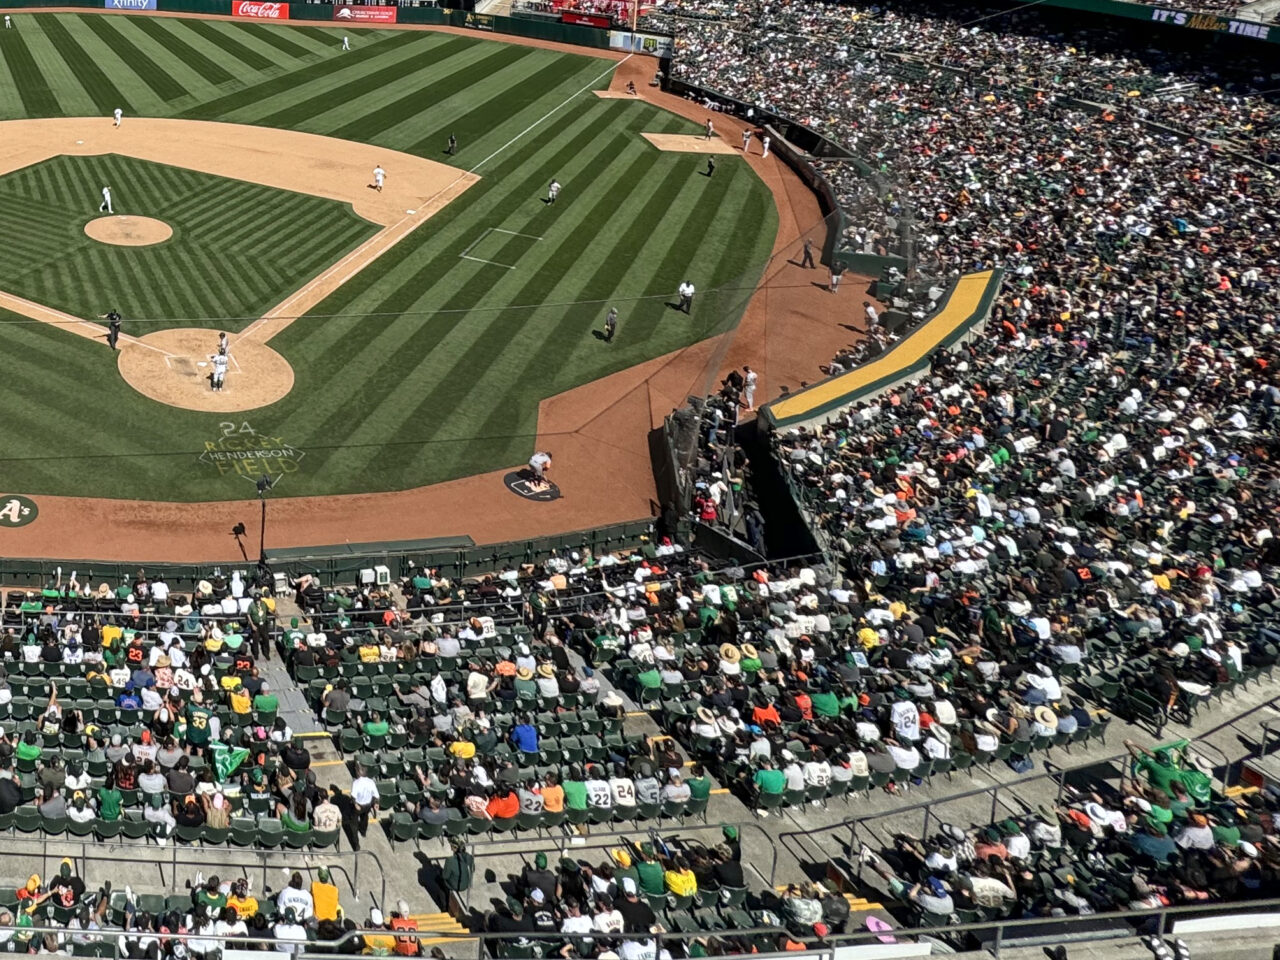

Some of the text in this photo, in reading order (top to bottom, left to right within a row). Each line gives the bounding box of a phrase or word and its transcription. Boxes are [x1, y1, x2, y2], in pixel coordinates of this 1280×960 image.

[238, 1, 282, 18] Coca-Cola
[1152, 9, 1270, 40] IT'S Miller TIME
[220, 421, 256, 437] 24
[204, 437, 284, 452] RICKEY
[209, 449, 294, 461] HENDERSON
[215, 459, 300, 476] FIELD
[128, 647, 143, 661] 23
[177, 674, 190, 688] 24
[192, 717, 207, 729] 33
[903, 714, 916, 728] 24
[617, 785, 634, 798] 24
[524, 798, 542, 813] 22
[594, 793, 609, 806] 22
